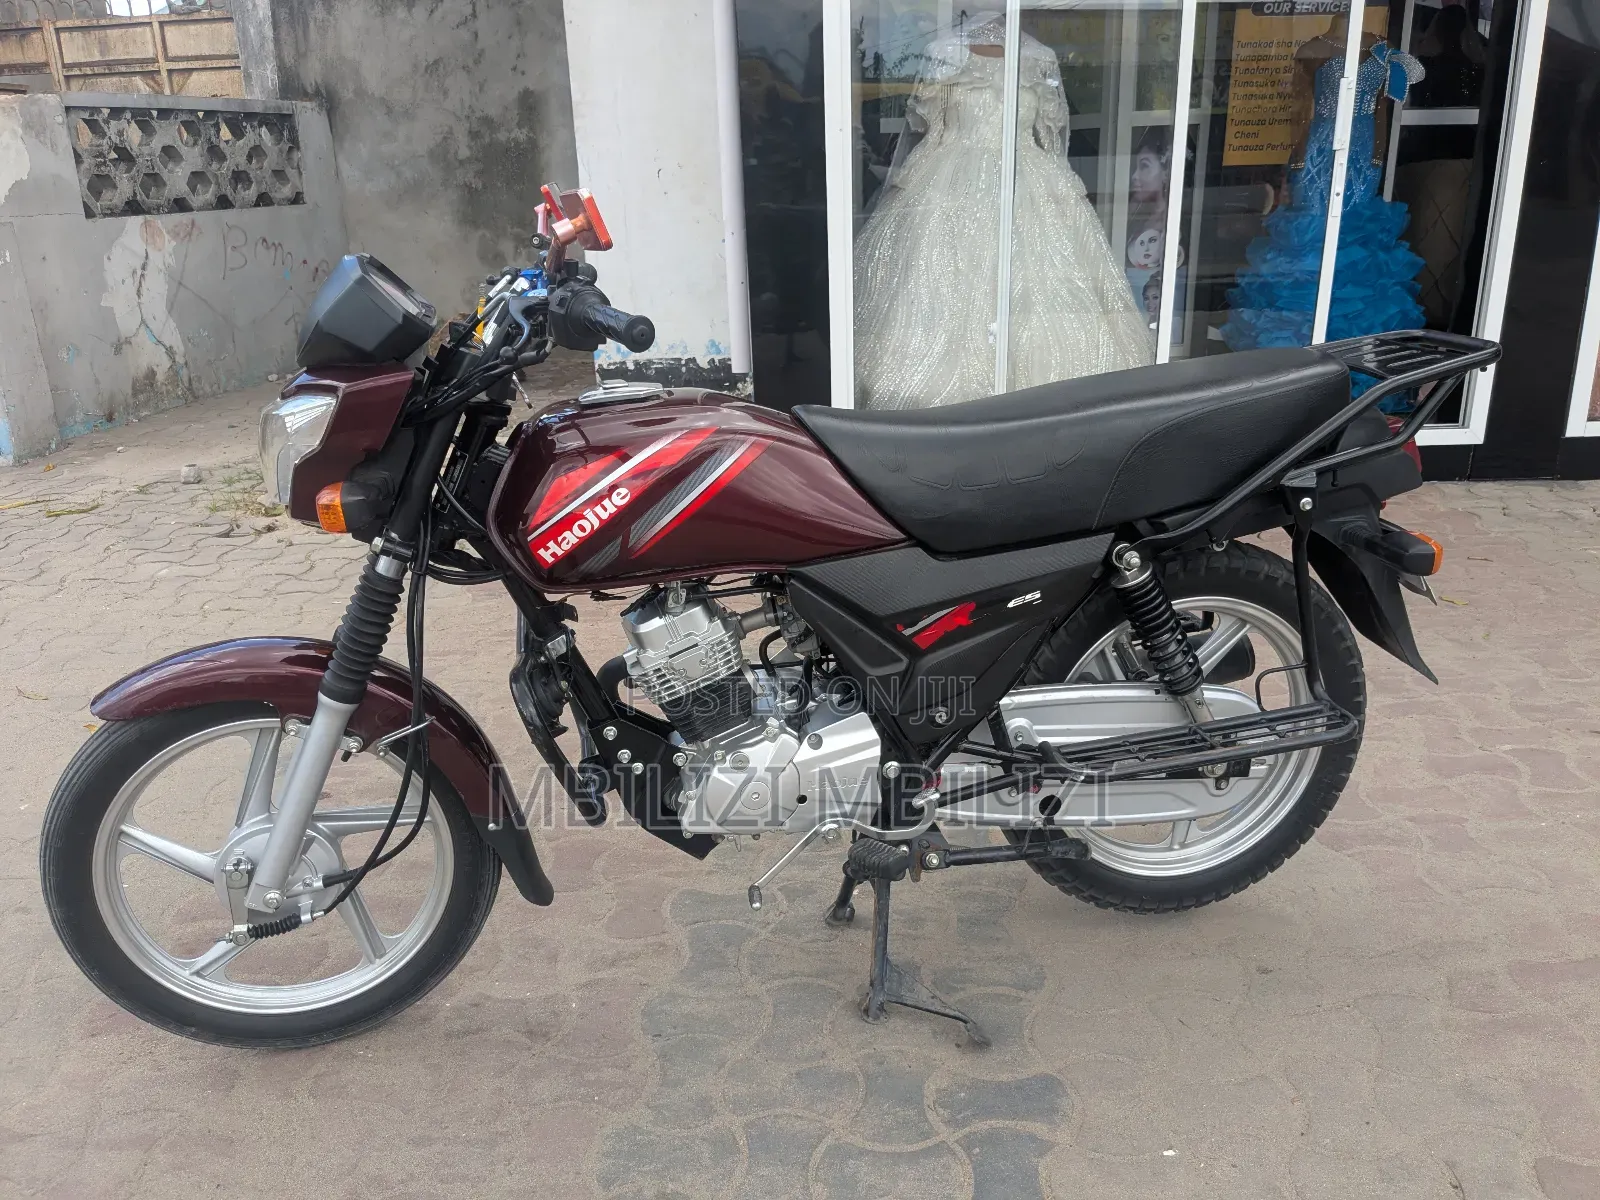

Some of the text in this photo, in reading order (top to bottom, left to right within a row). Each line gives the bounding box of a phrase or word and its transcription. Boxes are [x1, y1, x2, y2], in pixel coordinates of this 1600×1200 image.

[1263, 0, 1349, 14] OUR SERVICE
[1234, 66, 1280, 77] Tunafanya
[1233, 78, 1275, 88] Tunasuka
[1232, 92, 1274, 101] Tunasuka
[1230, 118, 1266, 126] Tunauza
[1233, 130, 1259, 139] Cheni
[1228, 143, 1264, 152] Tunauza
[537, 487, 631, 564] Haojue
